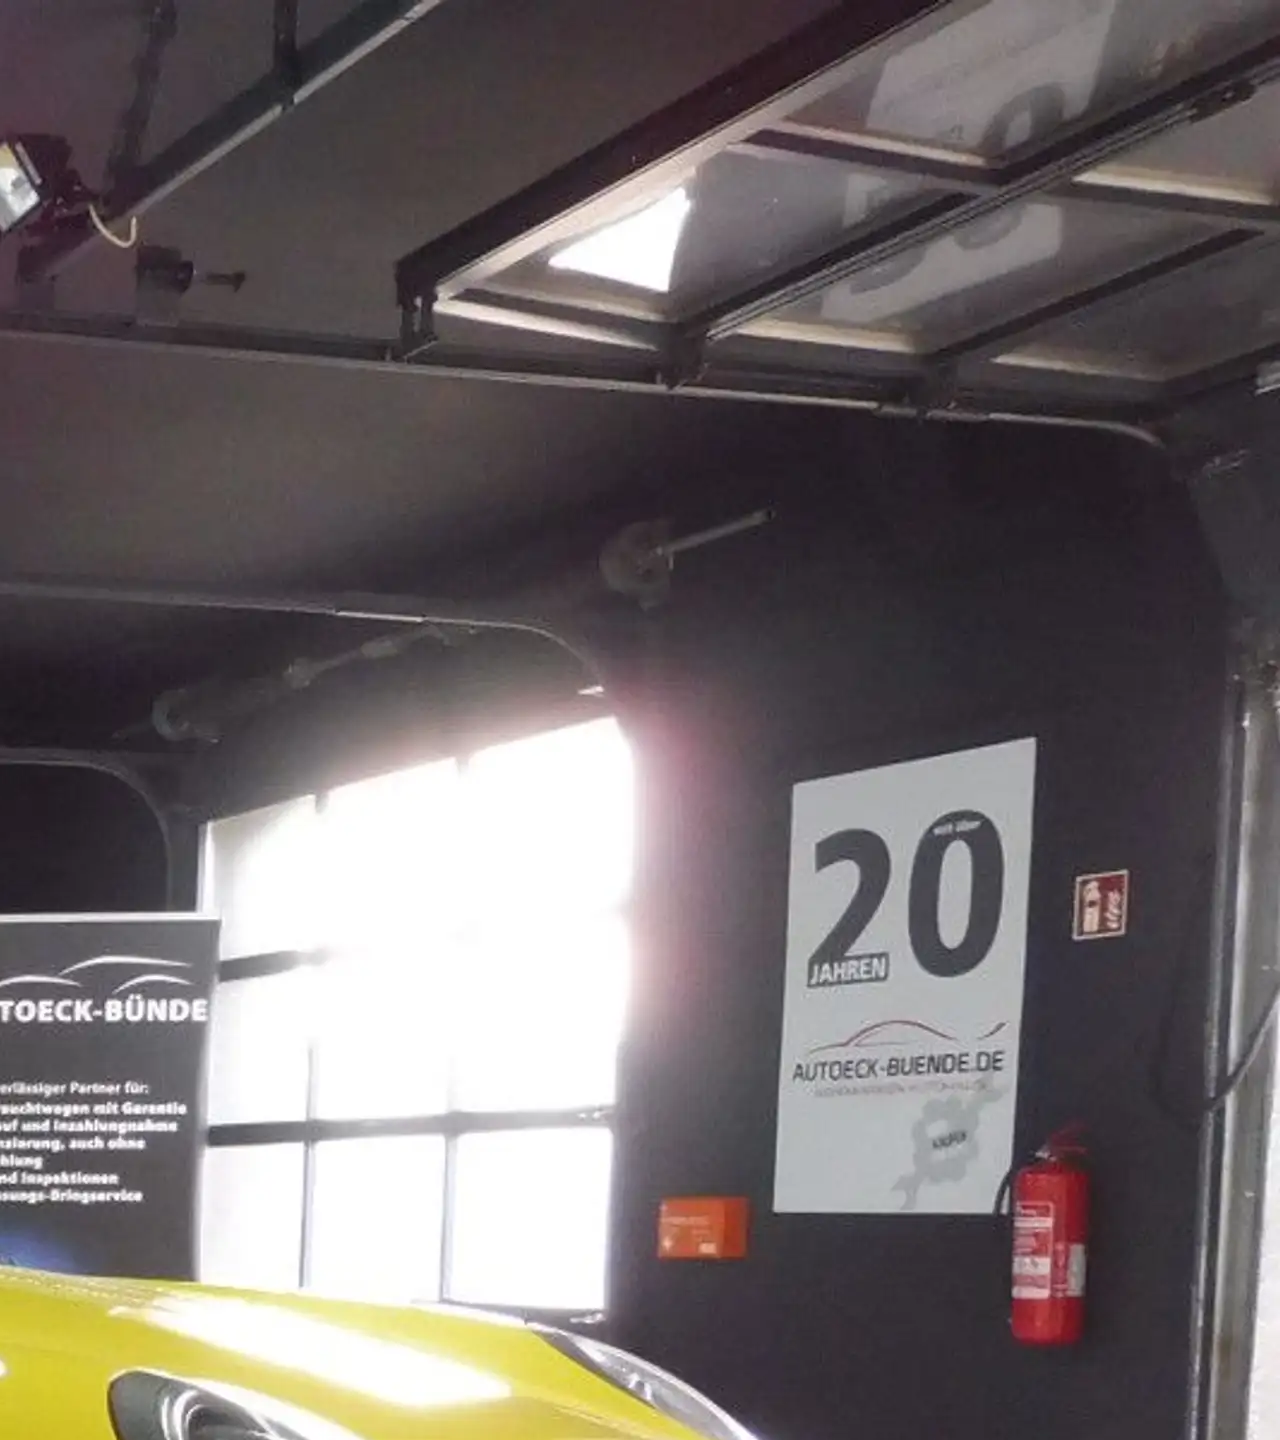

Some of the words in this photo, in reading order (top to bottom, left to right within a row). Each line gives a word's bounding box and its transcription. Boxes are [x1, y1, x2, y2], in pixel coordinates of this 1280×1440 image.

[808, 809, 1004, 978] 20
[810, 957, 886, 985] JAHREN
[792, 1051, 1006, 1083] AUTOECK-BUENDE.DE
[69, 1081, 121, 1094] Partner
[92, 1102, 119, 1115] mit
[21, 1119, 50, 1132] und
